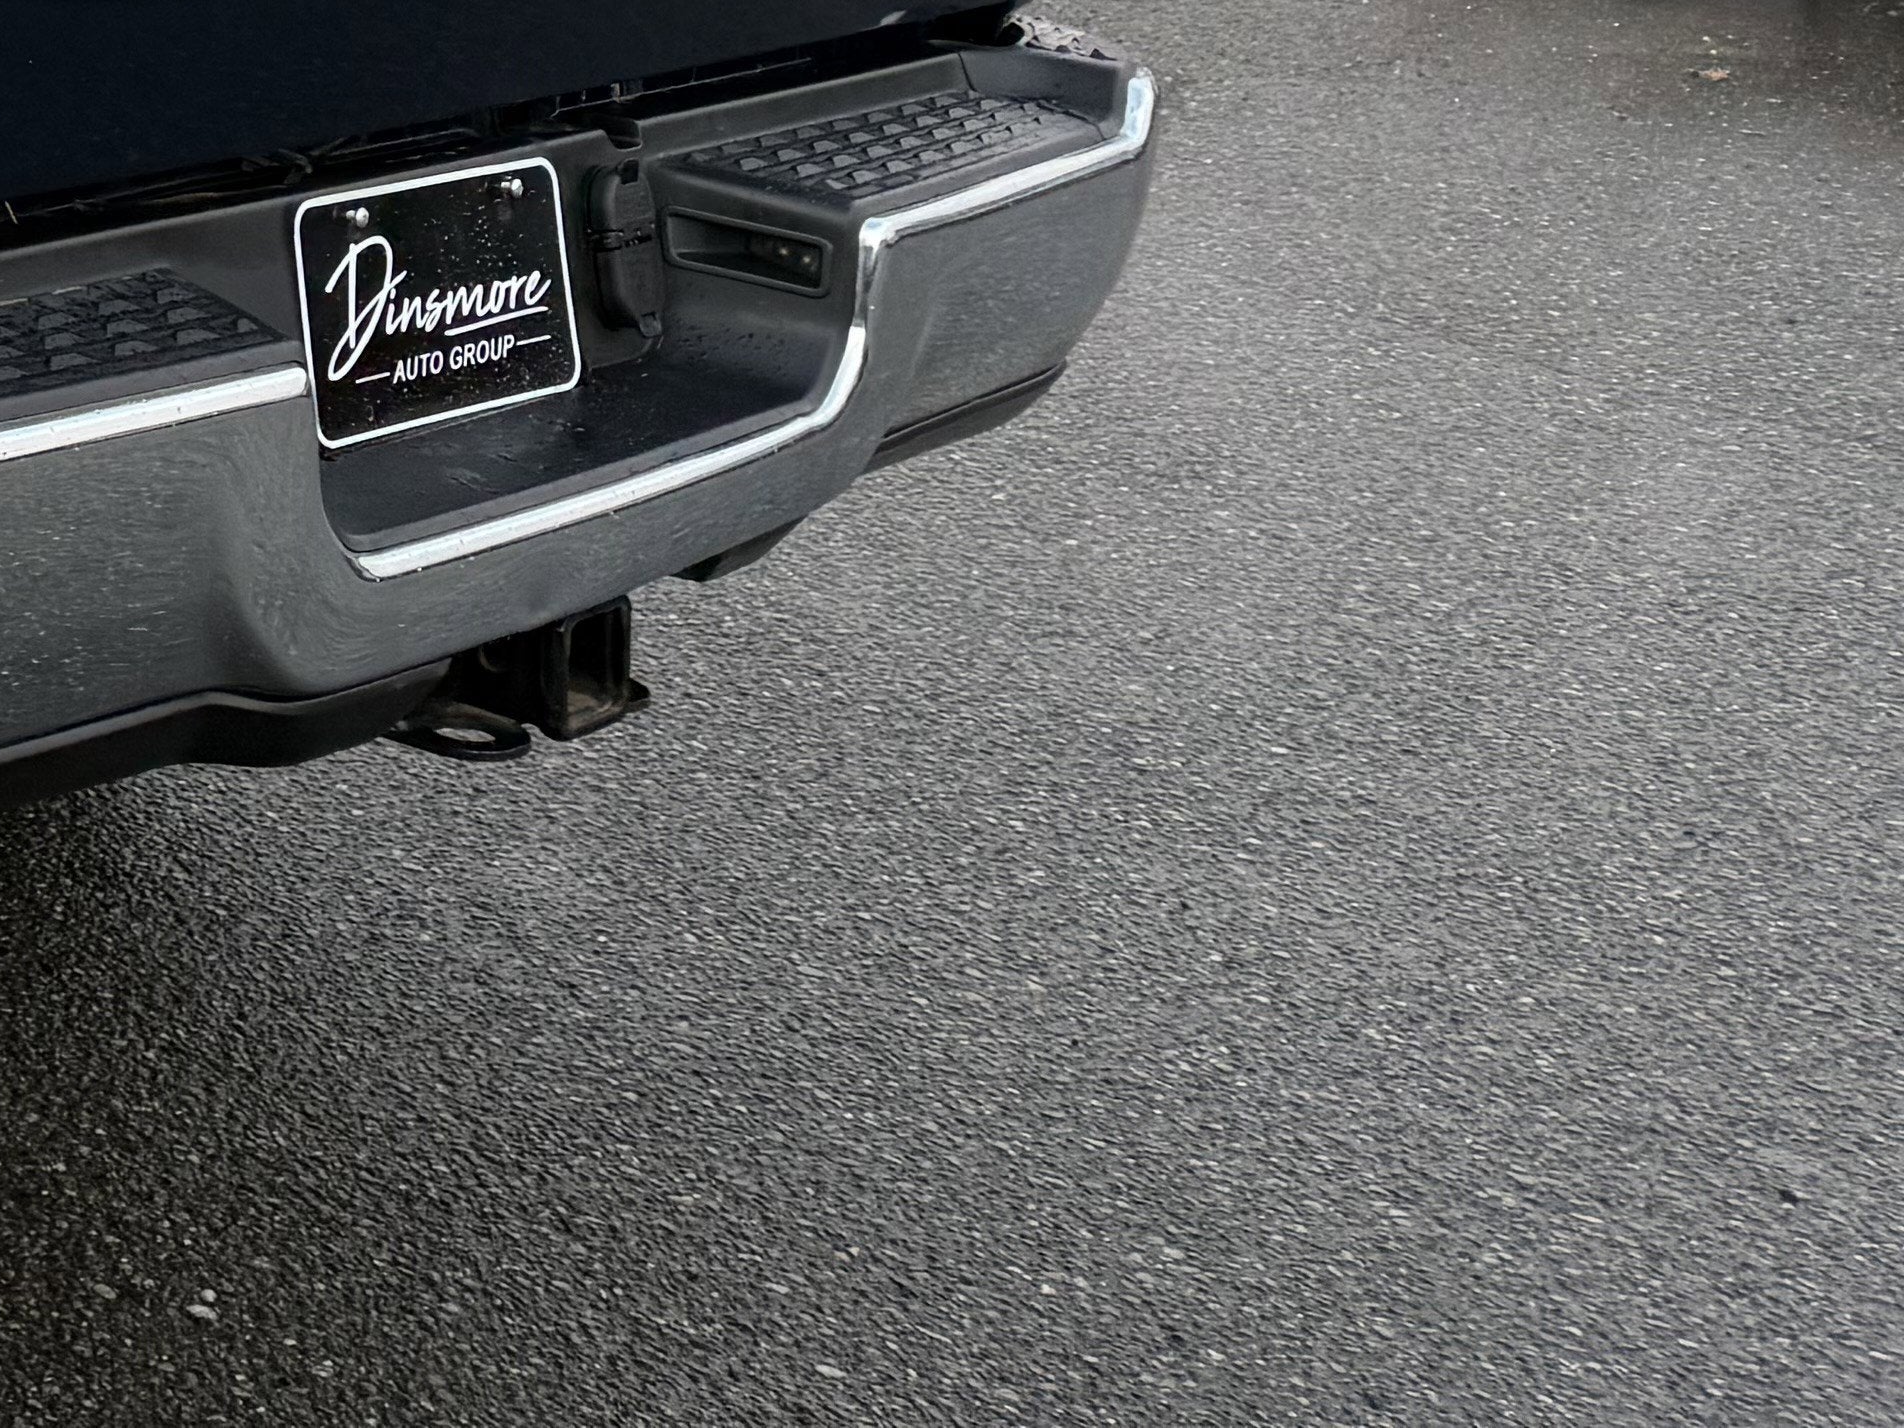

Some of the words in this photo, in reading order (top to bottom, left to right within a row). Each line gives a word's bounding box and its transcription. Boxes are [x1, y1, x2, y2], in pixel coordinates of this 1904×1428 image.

[325, 235, 551, 381] Dinsmore
[392, 348, 444, 384] AUTO
[449, 334, 517, 372] GROUP
